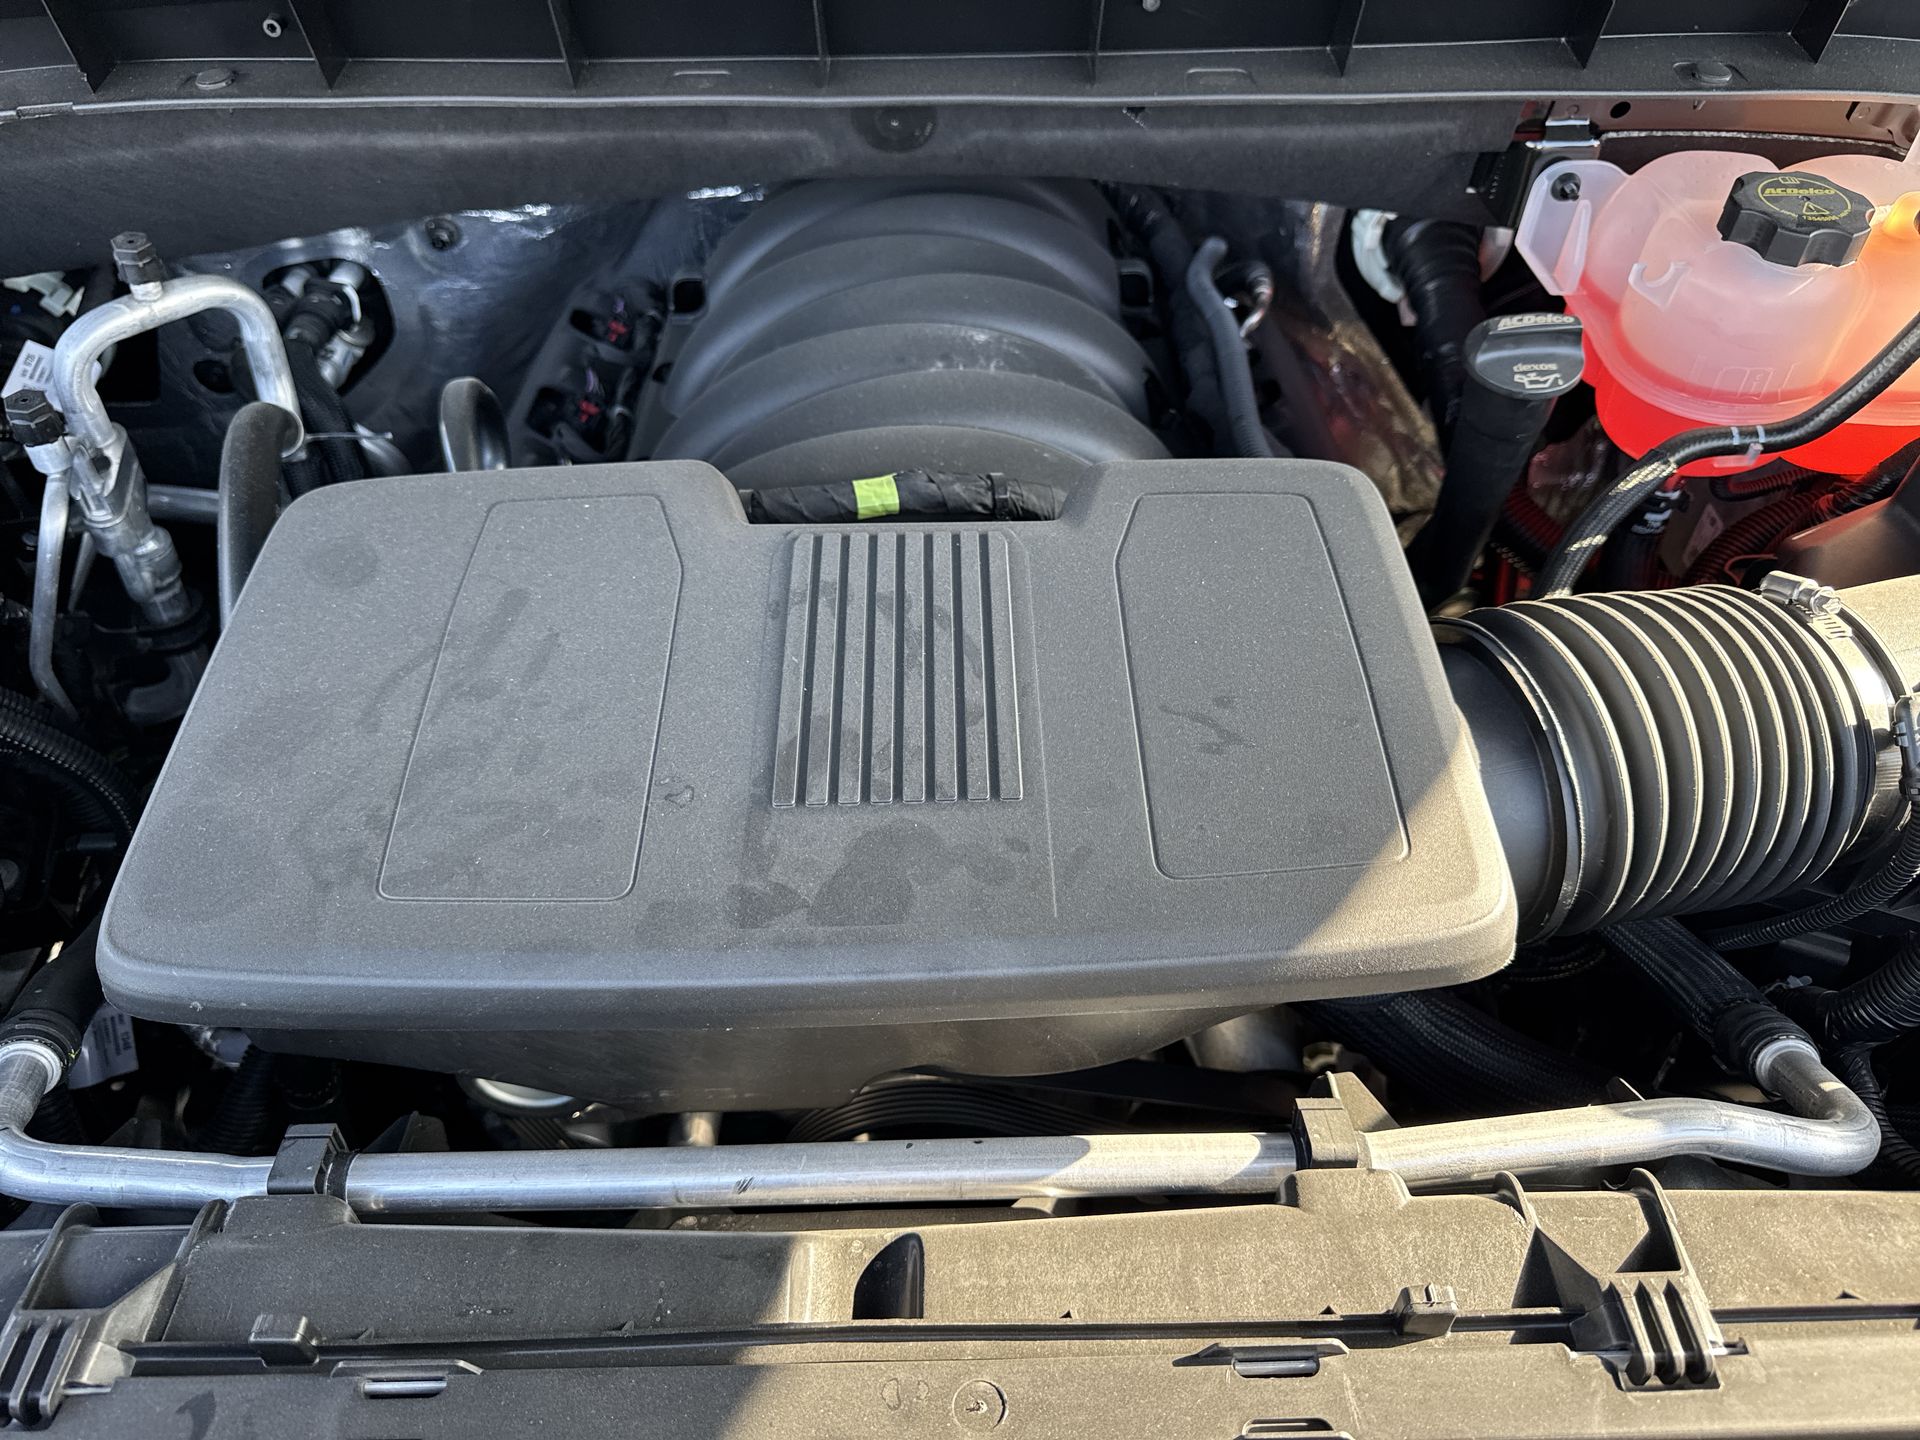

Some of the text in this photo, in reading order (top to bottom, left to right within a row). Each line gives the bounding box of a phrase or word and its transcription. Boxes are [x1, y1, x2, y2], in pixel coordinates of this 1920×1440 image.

[1764, 187, 1835, 196] ACDelco
[1498, 314, 1575, 330] ACDelco
[1513, 363, 1558, 372] dexos
